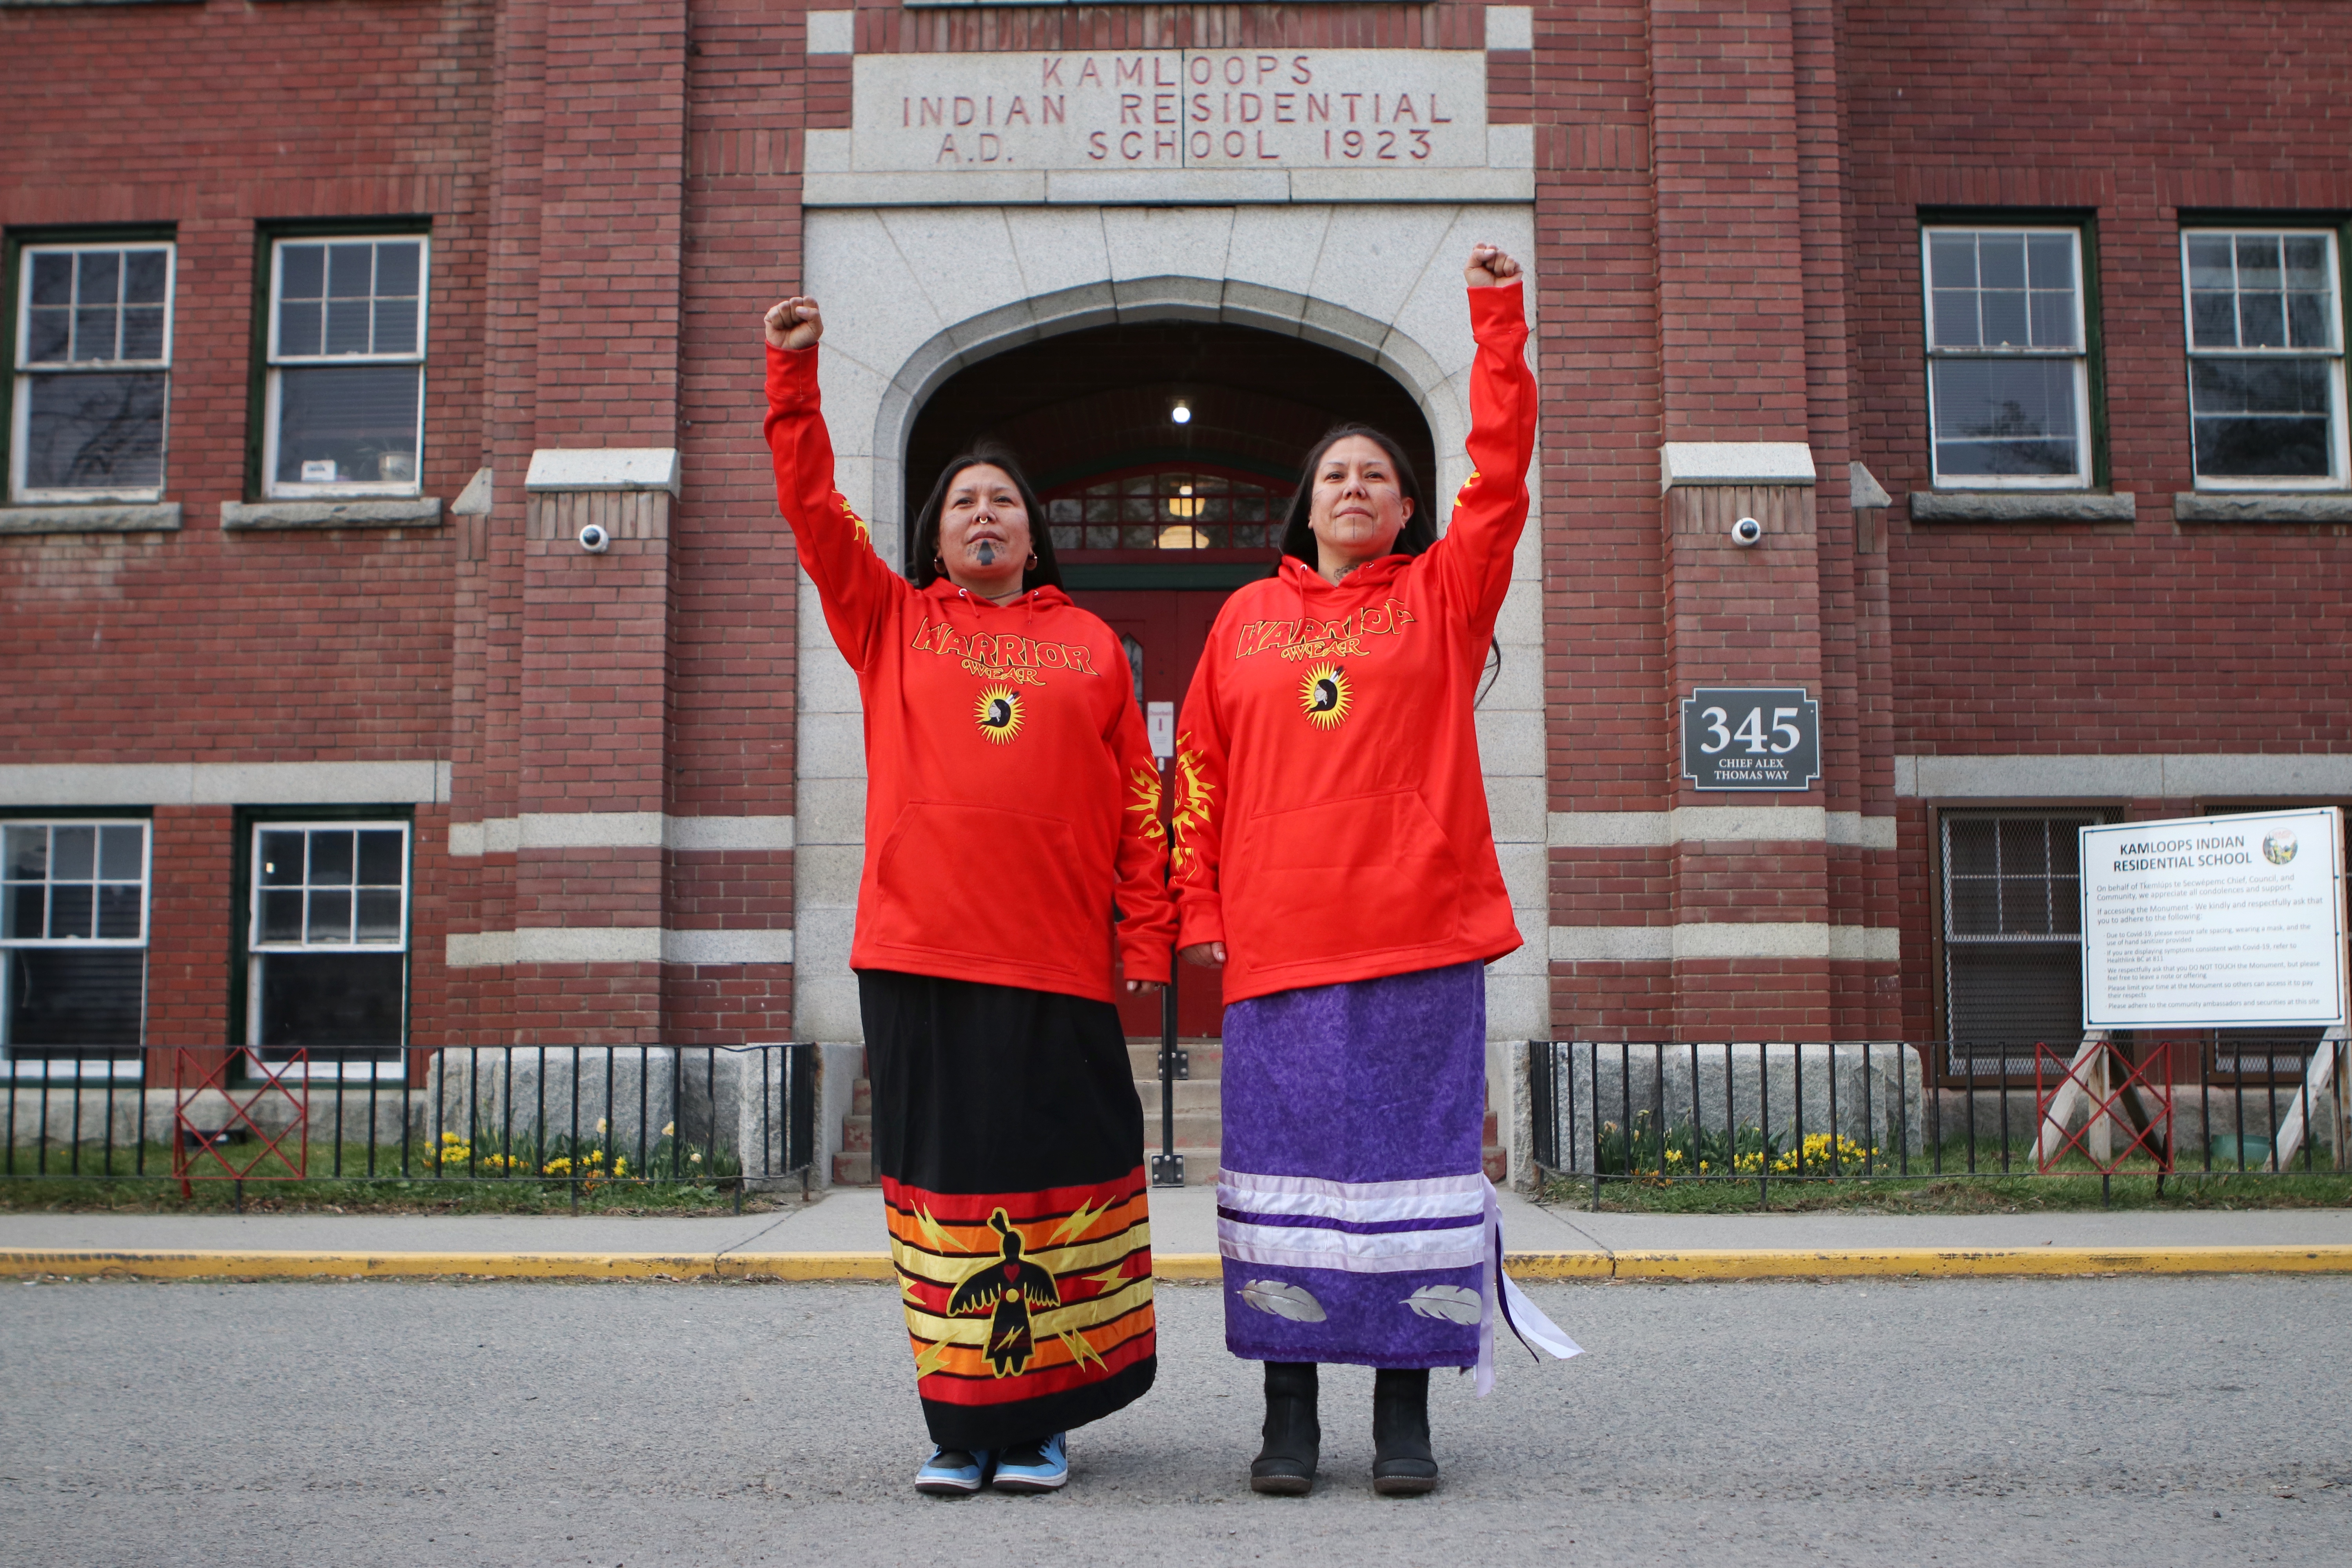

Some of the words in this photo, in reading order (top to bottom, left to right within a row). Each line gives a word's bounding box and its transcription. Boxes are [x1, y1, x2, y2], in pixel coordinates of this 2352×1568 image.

[1042, 56, 1312, 87] KAMLOOPS
[903, 94, 1065, 127] INDIAN
[1120, 93, 1452, 123] RESIDENTIAL
[936, 132, 1013, 163] A.D.
[1087, 130, 1279, 160] SCHOOL
[1324, 129, 1432, 159] 1923
[1235, 598, 1415, 659] WARRIOR
[911, 616, 1100, 676] WARRIOR
[1280, 638, 1370, 661] WEAR
[961, 659, 1047, 686] WEAR
[1700, 706, 1800, 753] 345
[1719, 759, 1753, 768] CHIEF
[1755, 759, 1784, 768] ALEX
[1714, 770, 1763, 780] THOMAS
[1765, 770, 1789, 780] WAY
[2121, 839, 2192, 855] KAMLOOPS
[2197, 835, 2244, 849] INDIAN
[2114, 856, 2194, 871] RESIDENTIAL
[2198, 852, 2252, 866] SCHOOL
[2108, 883, 2129, 891] behalf
[2151, 889, 2187, 899] appreciate
[2200, 887, 2244, 895] condolences
[2246, 884, 2259, 893] and
[2104, 907, 2135, 915] accessing
[2150, 904, 2189, 913] Monument
[2209, 901, 2230, 910] kindly
[2232, 900, 2246, 908] and
[2248, 898, 2291, 908] respectfully
[2166, 936, 2192, 944] provided
